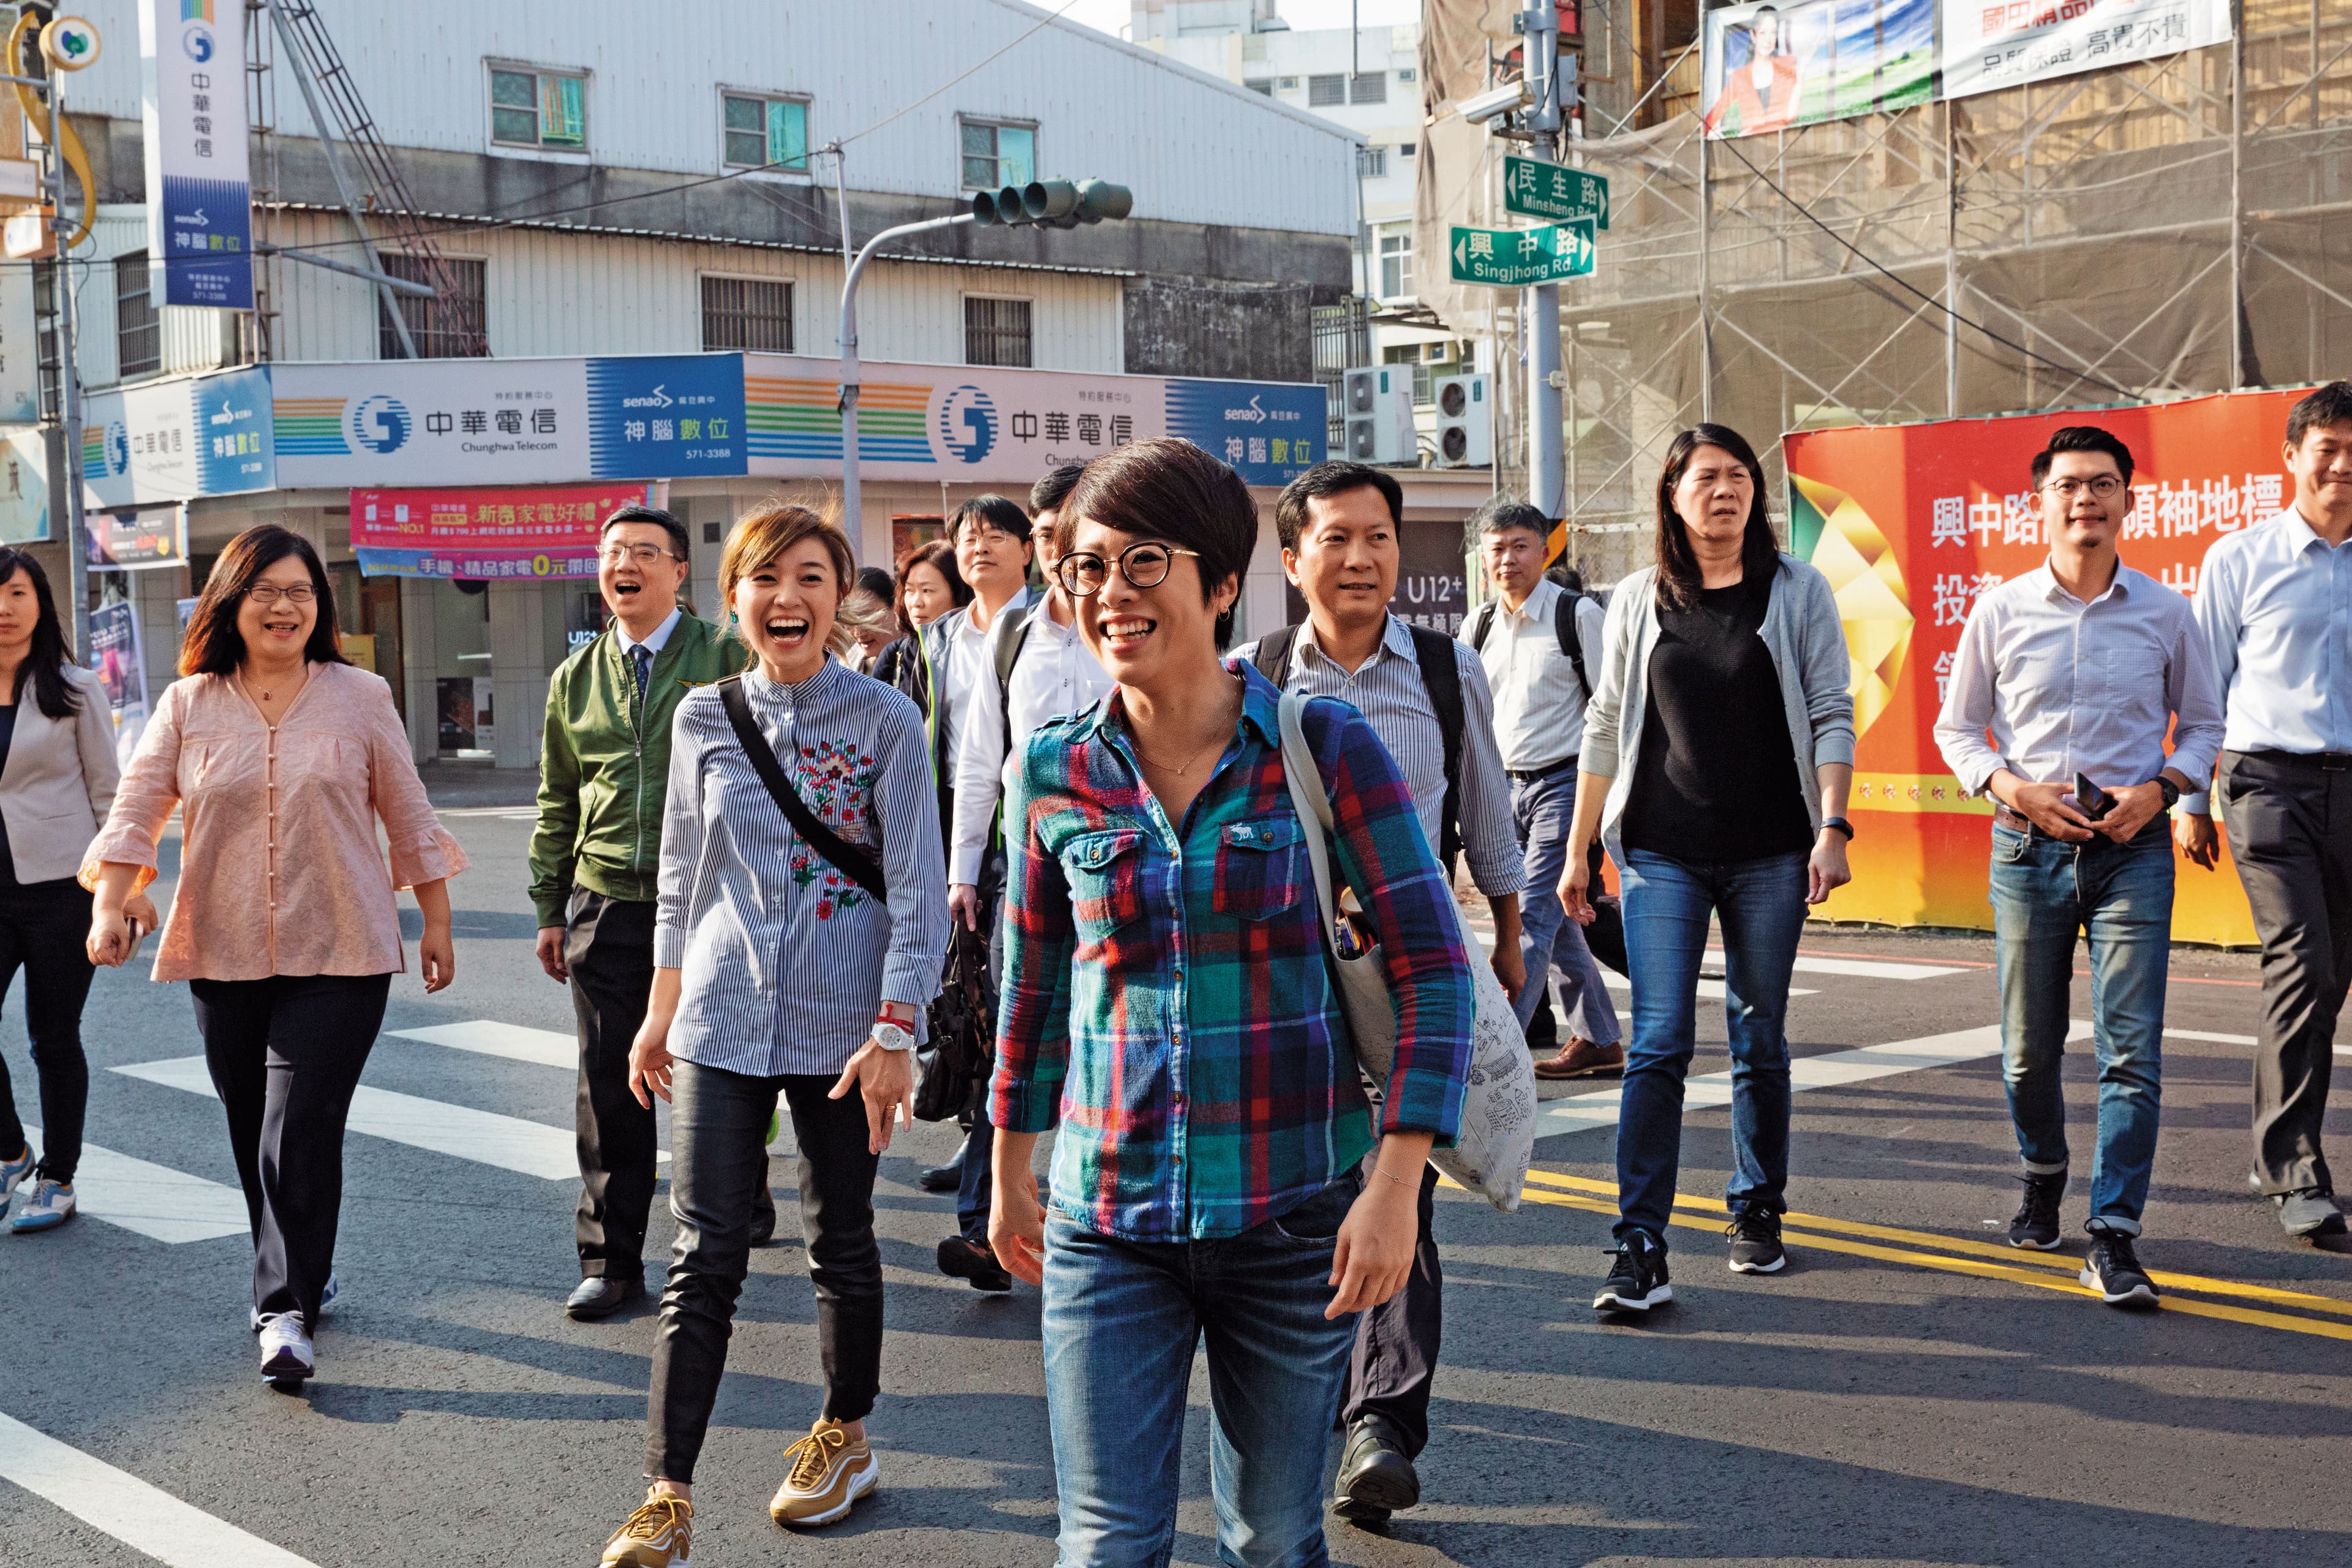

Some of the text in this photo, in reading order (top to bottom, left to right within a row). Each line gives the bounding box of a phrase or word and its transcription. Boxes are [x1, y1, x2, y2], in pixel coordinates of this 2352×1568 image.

[2087, 14, 2187, 58] 高貴不貴
[191, 72, 212, 158] 中華電信
[1518, 162, 1598, 206] 民生路
[1523, 194, 1574, 217] Minsheng
[1468, 227, 1579, 261] 興中路
[1474, 257, 1575, 282] Singjhong Rd.
[623, 397, 662, 408] senao
[1224, 409, 1257, 421] senao
[426, 409, 557, 436] 中華電信
[624, 418, 729, 442] 神腦數位
[1012, 410, 1133, 447] 中華電信
[133, 429, 182, 455] 中華電信
[214, 431, 260, 458] 神腦數位
[461, 440, 557, 454] Chunghwa Telecom
[1225, 435, 1311, 464] 神腦數位
[398, 523, 425, 534] NO.1
[1408, 576, 1463, 603] U12+
